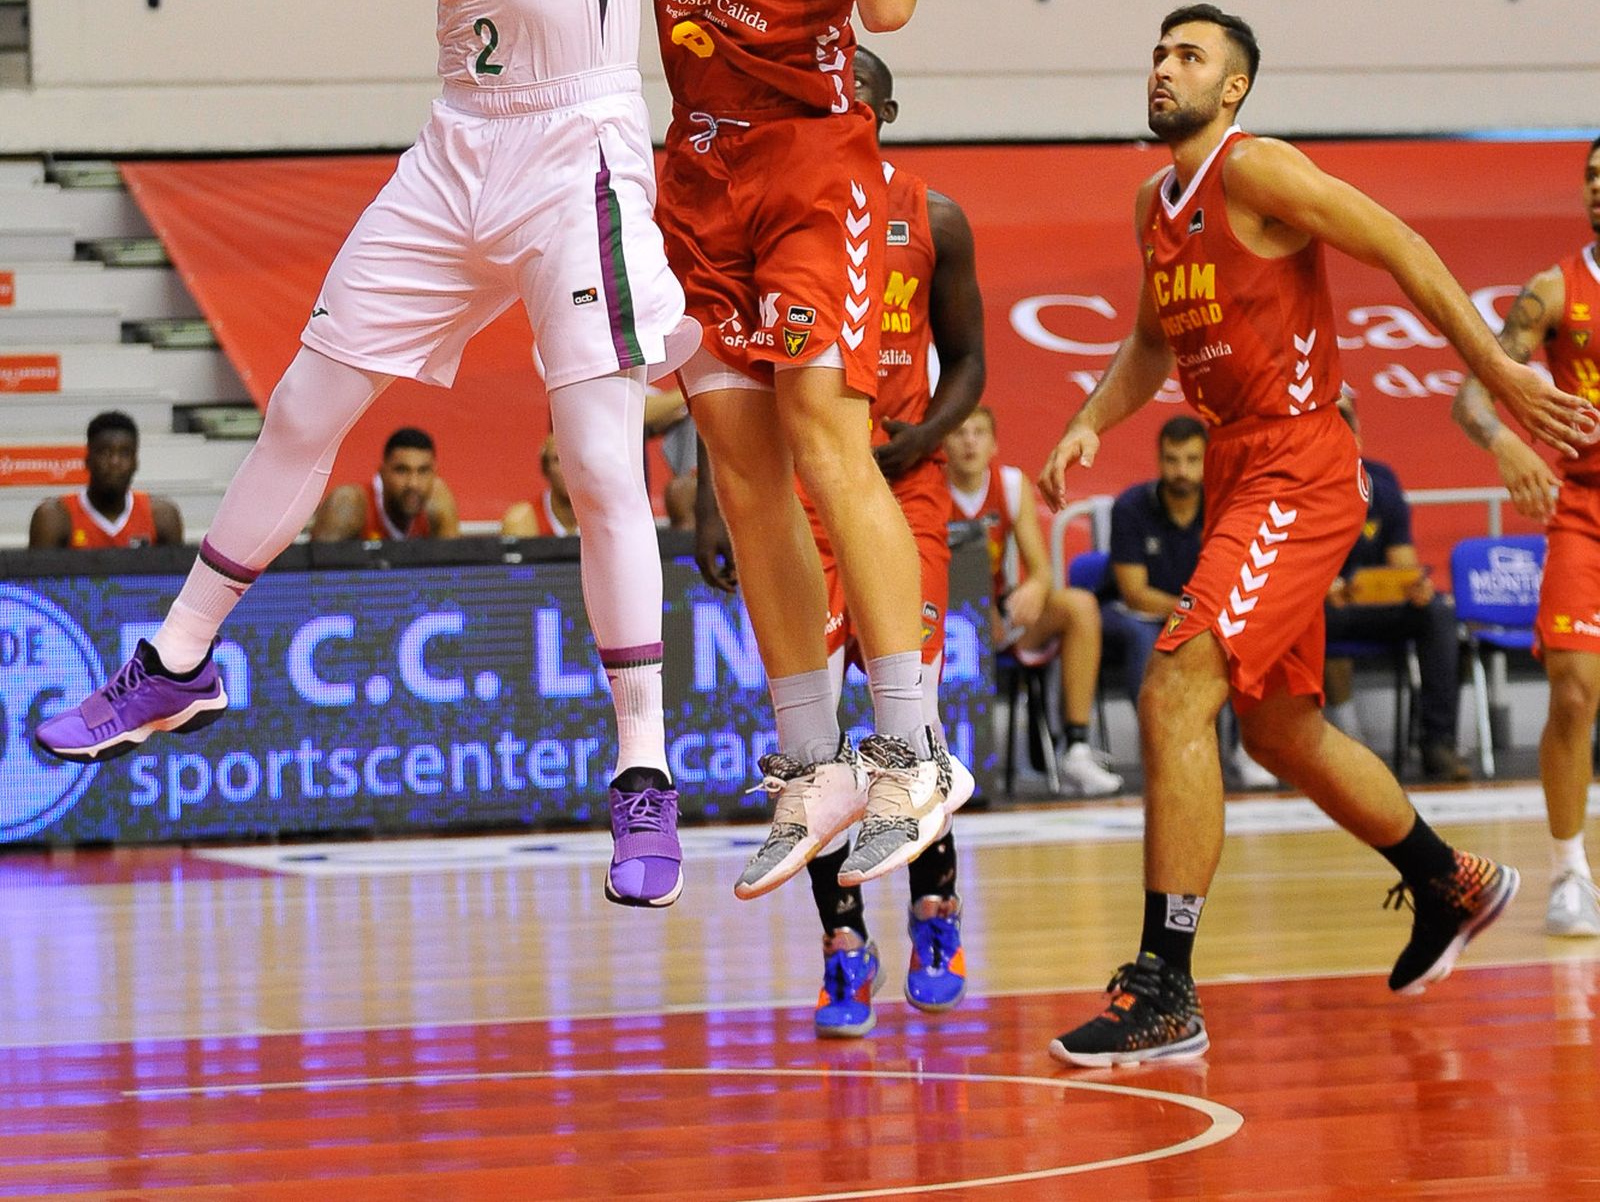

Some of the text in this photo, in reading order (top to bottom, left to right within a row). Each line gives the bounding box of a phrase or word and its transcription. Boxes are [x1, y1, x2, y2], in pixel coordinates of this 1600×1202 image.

[473, 17, 504, 76] 2
[1153, 263, 1217, 310] CAM
[288, 611, 501, 709] C.C.
